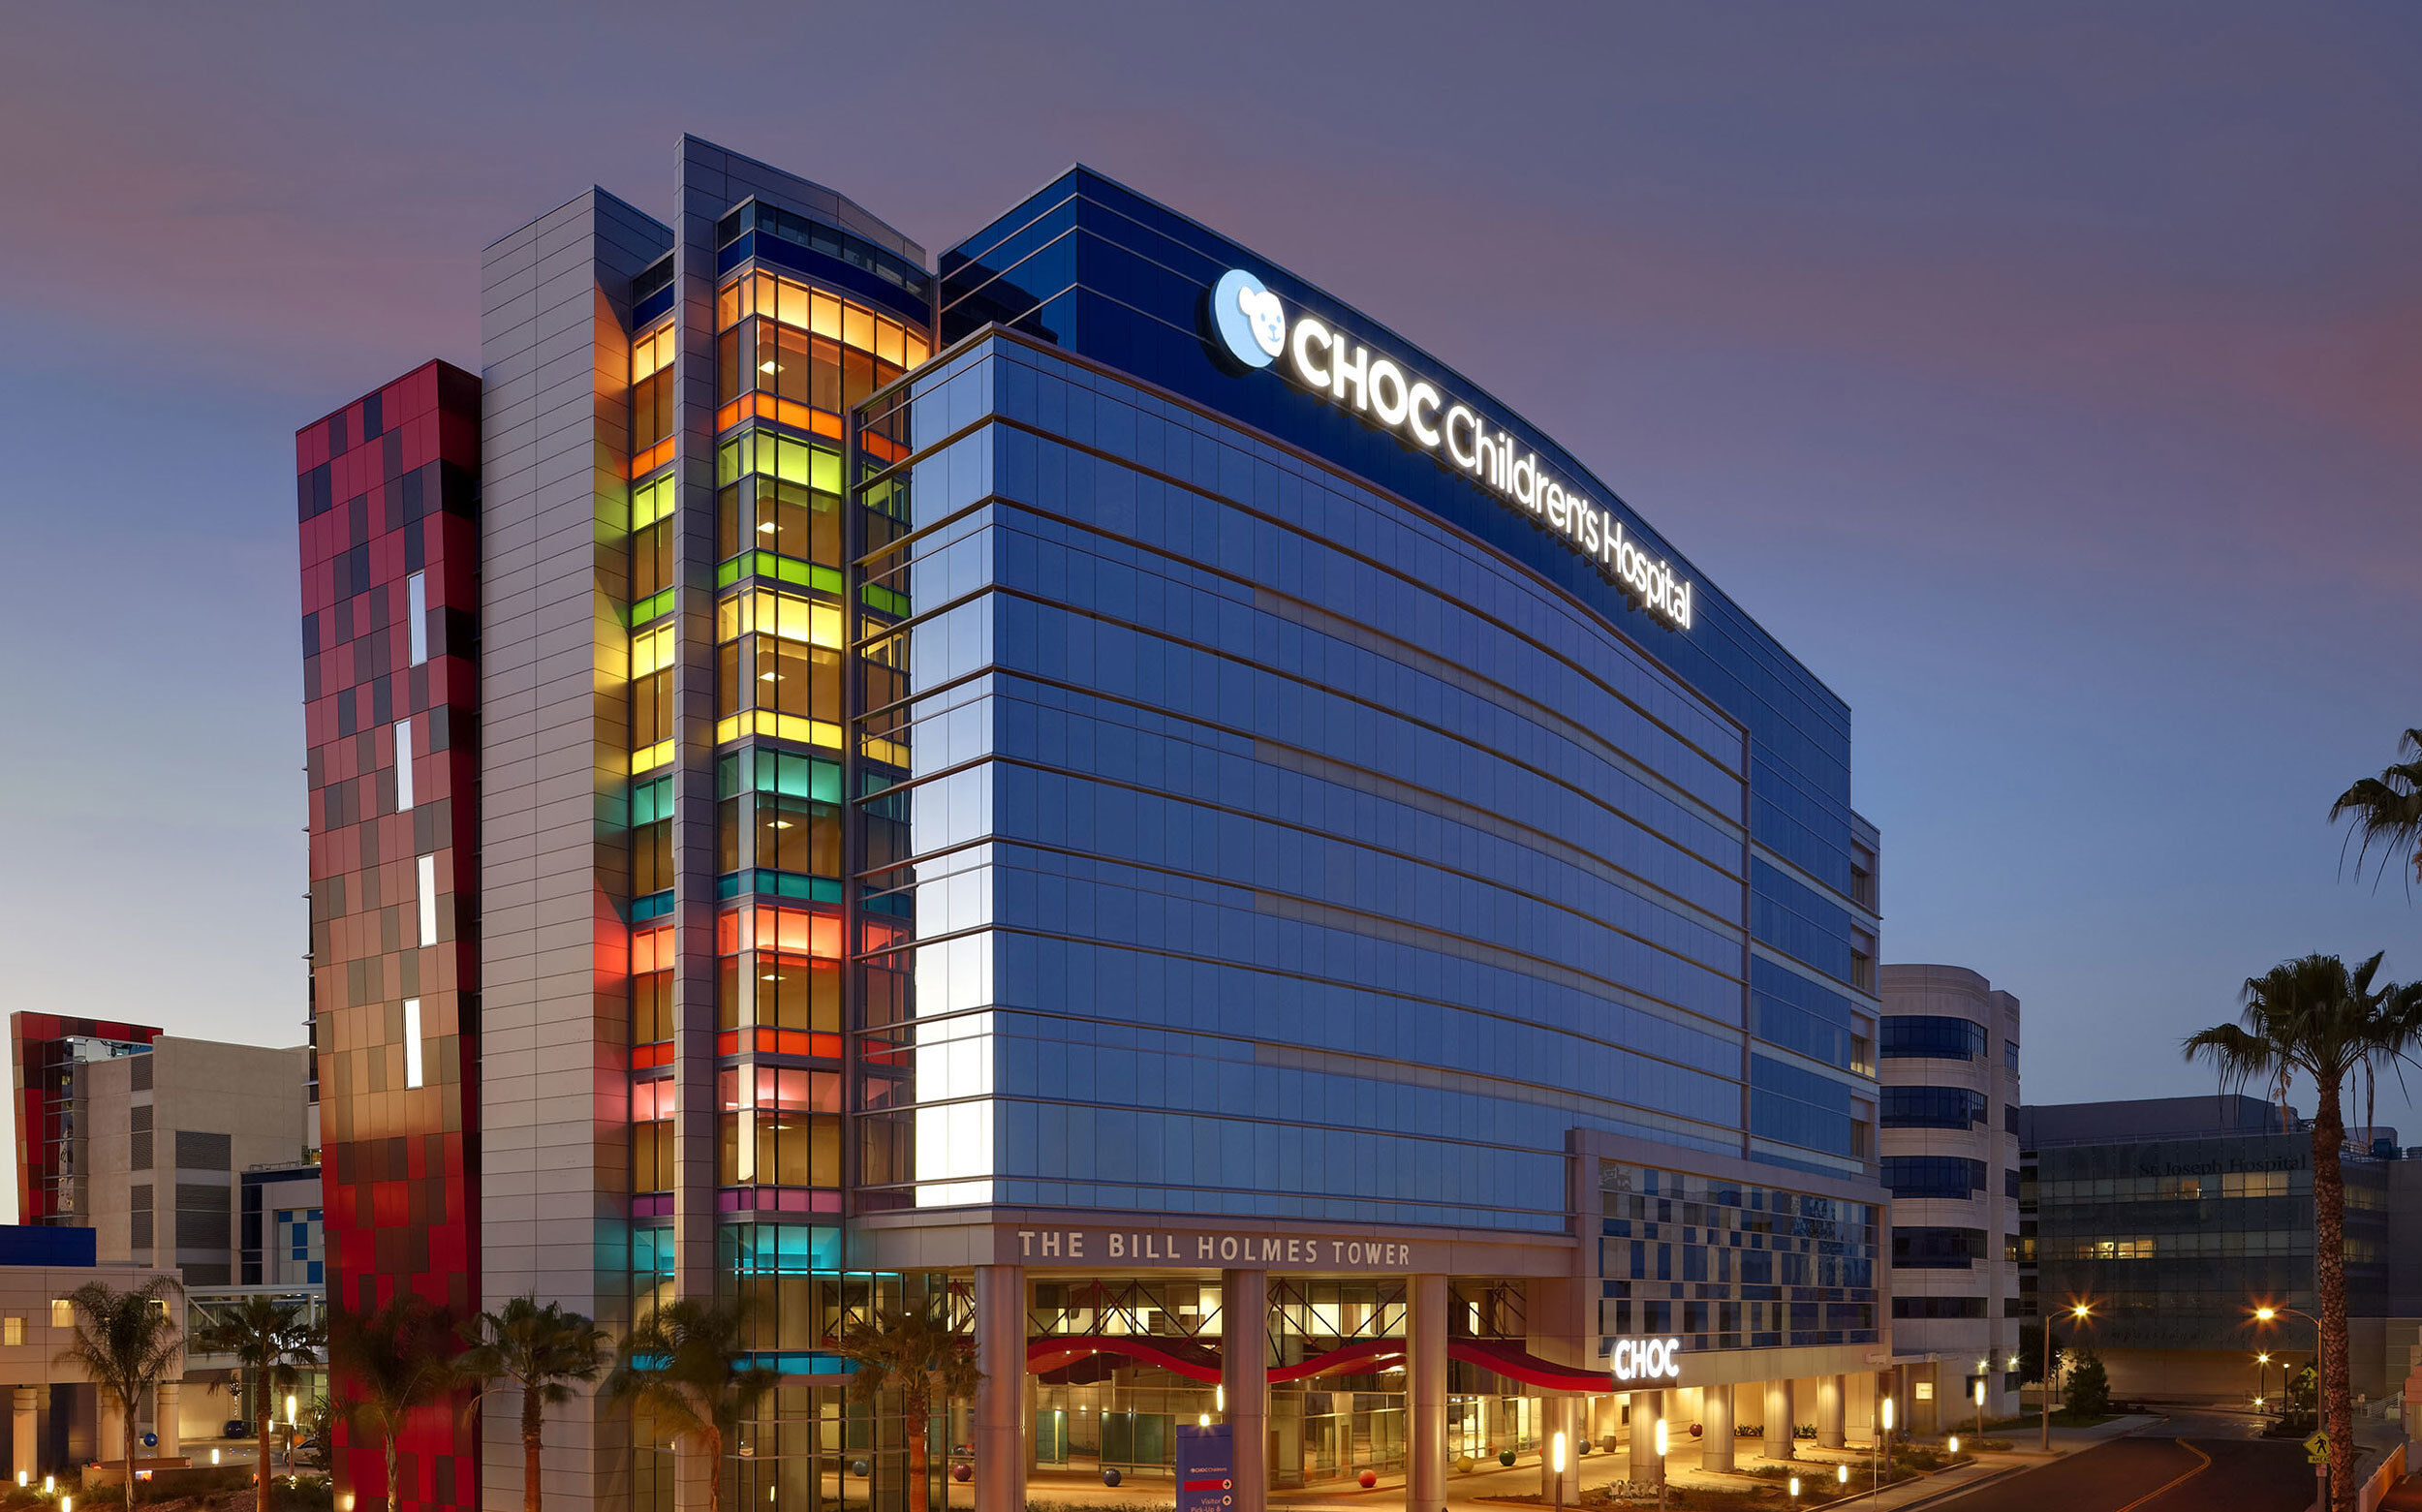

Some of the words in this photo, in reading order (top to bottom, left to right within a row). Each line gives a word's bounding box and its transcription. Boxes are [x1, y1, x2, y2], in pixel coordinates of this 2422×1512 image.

[1292, 319, 1441, 447] CHOC
[1446, 406, 1599, 553] Children's
[1604, 511, 1691, 630] Hospital
[2166, 1158, 2222, 1177] Joseph
[2230, 1154, 2306, 1172] Hospital
[1018, 1231, 1083, 1257] THE
[1109, 1233, 1181, 1259] BILL
[1197, 1236, 1317, 1263] HOLMES
[1332, 1241, 1410, 1265] TOWER
[1615, 1338, 1680, 1380] CHOC
